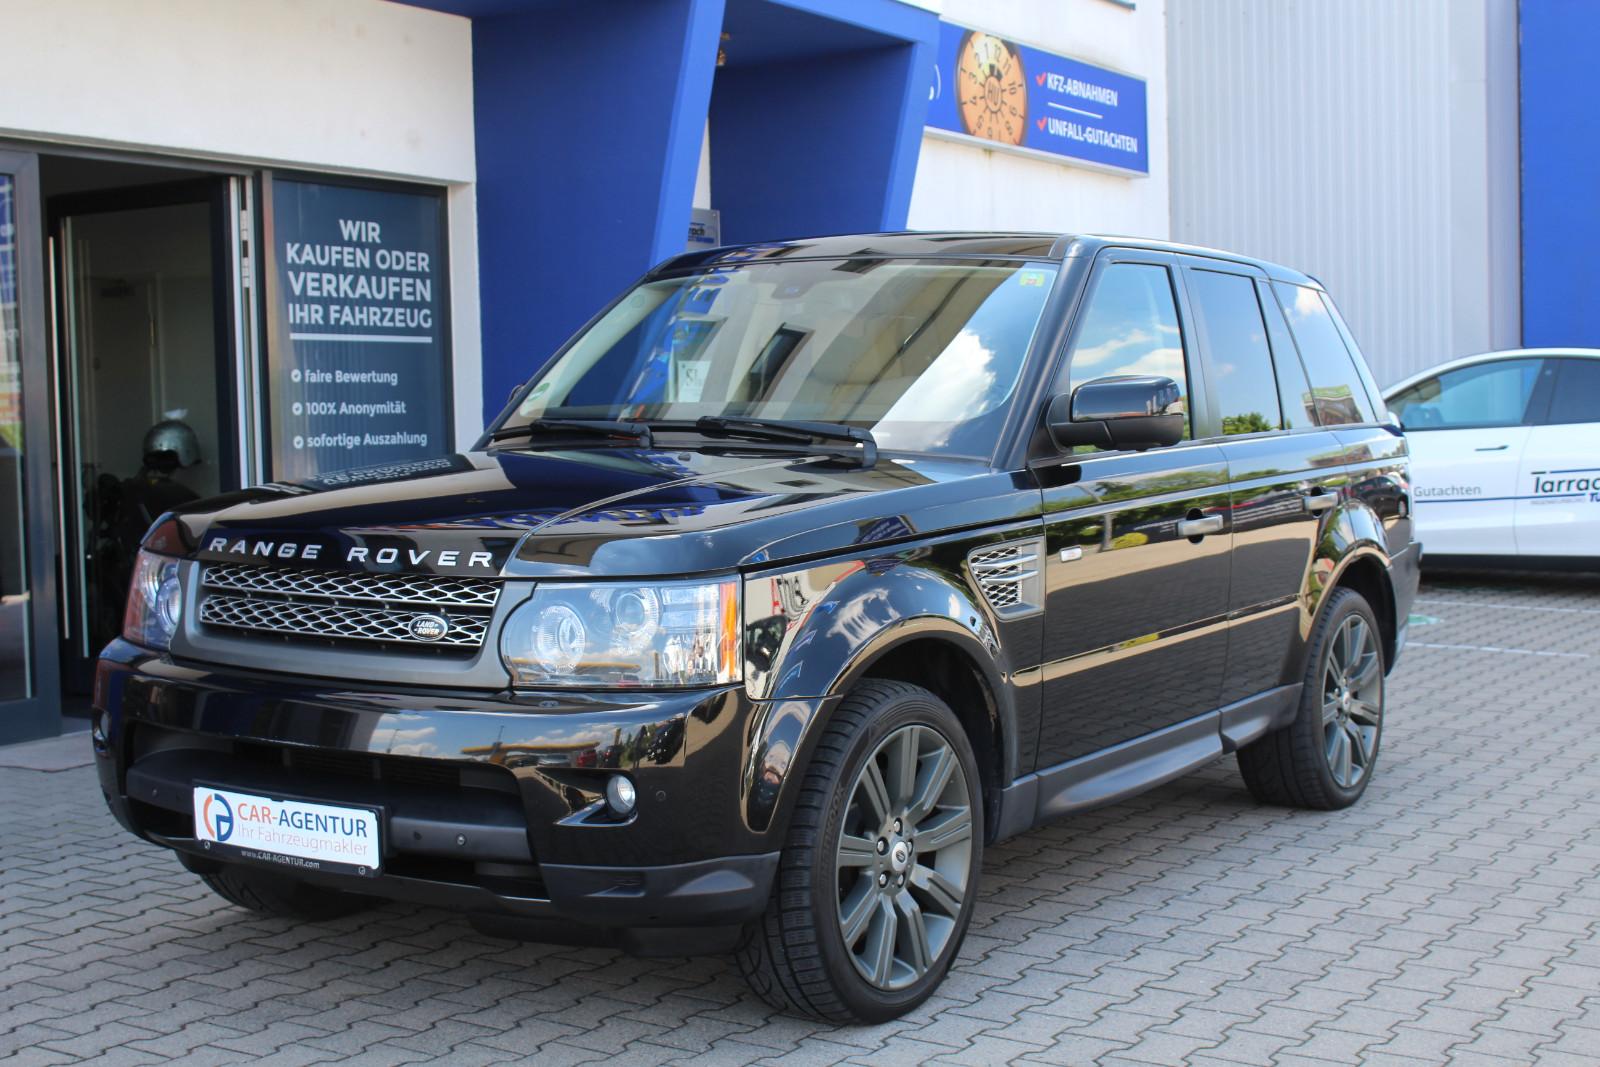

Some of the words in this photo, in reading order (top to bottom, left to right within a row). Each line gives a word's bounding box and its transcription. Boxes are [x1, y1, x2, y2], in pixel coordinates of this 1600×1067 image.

[1046, 72, 1118, 107] KFZ-ABNAHMEN
[1047, 117, 1138, 153] UNFALL-GUTACHTEN
[339, 219, 381, 244] WIR
[286, 243, 370, 269] KAUFEN
[376, 249, 430, 272] ODER
[288, 271, 431, 302] VERKAUFEN
[288, 303, 324, 325] IHR
[329, 304, 432, 328] FAHRZEUG
[305, 370, 332, 383] faire
[335, 370, 398, 386] Bewertung
[306, 402, 336, 415] 100%
[339, 400, 406, 417] Anonymität
[307, 434, 361, 448] sofortige
[363, 432, 428, 448] Auszahlung
[1414, 485, 1481, 498] Gutachten
[209, 537, 322, 560] RANGE
[346, 547, 493, 568] ROVER
[416, 621, 436, 629] LAND
[416, 628, 440, 636] ROVER
[237, 803, 368, 838] CAR-AGENTUR
[238, 824, 254, 840] Ihr
[258, 826, 368, 857] Fahrzeugmakler
